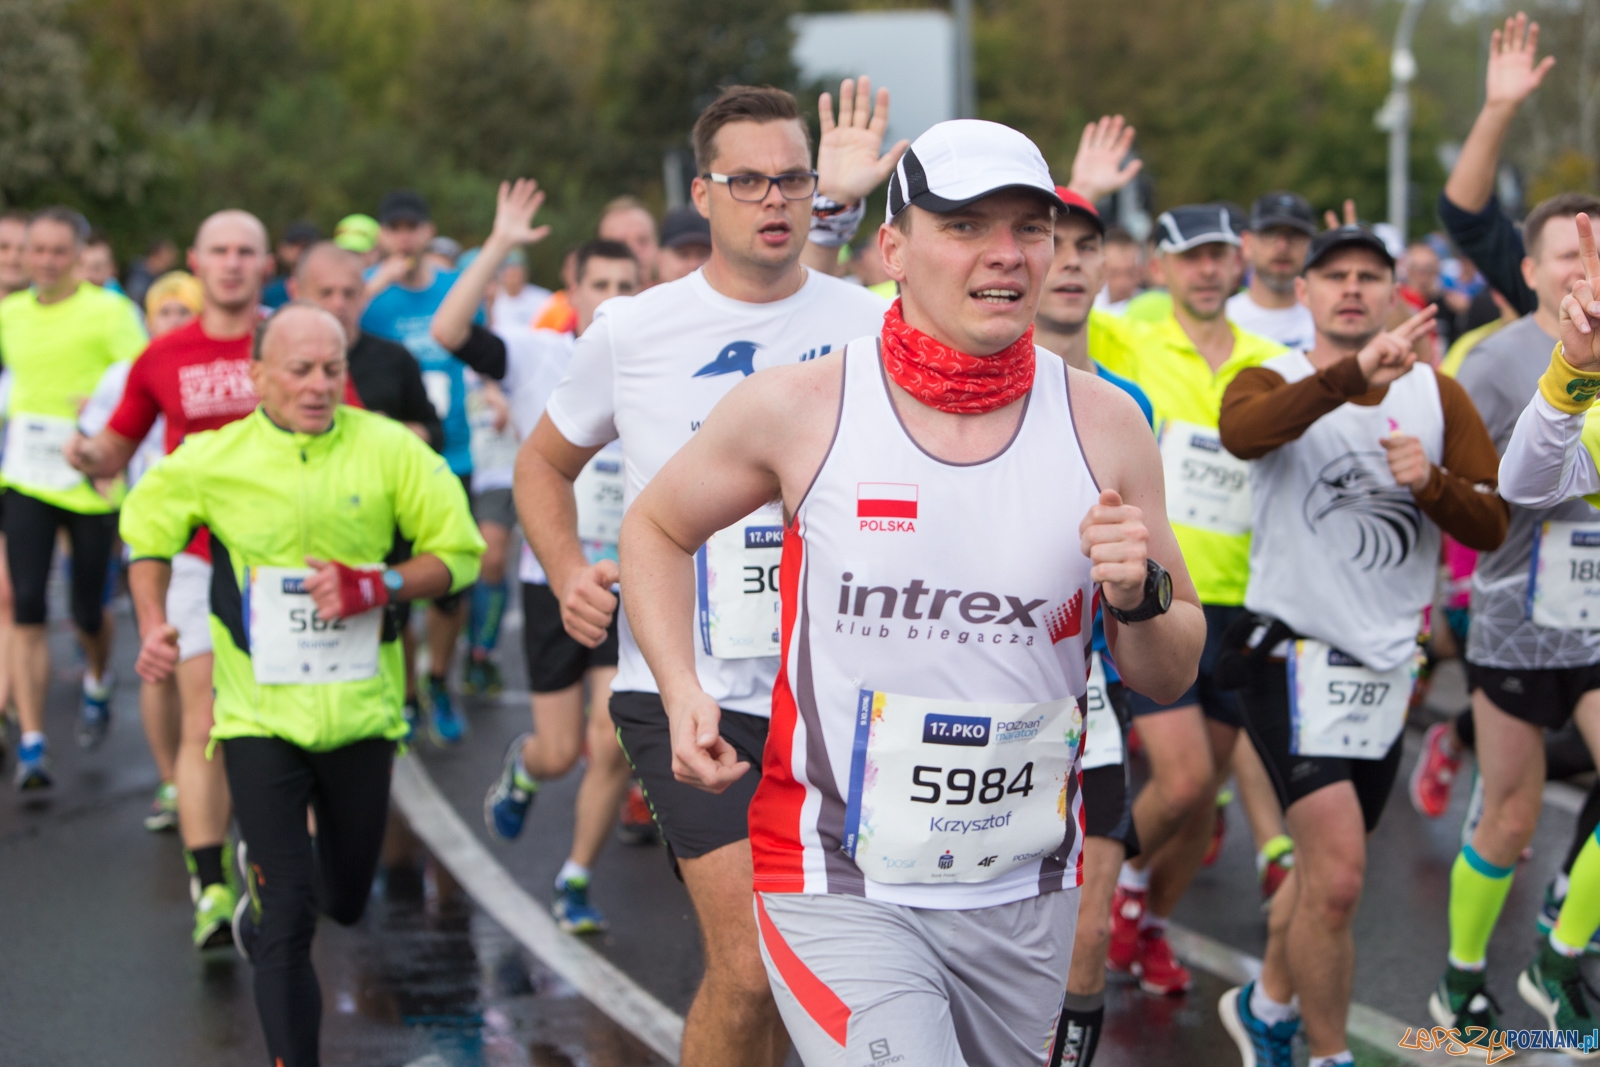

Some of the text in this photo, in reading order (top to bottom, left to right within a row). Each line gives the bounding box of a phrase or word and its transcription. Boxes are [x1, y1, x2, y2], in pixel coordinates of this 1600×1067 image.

[1182, 458, 1246, 491] 5799
[859, 520, 916, 532] POLSKA
[838, 571, 1049, 628] intrex
[835, 620, 1034, 646] klub biegacza
[1328, 680, 1391, 705] 5787
[951, 723, 986, 738] PKO
[995, 728, 1038, 742] maraton
[910, 761, 1034, 806] 5984
[930, 811, 1013, 834] Krzysztof
